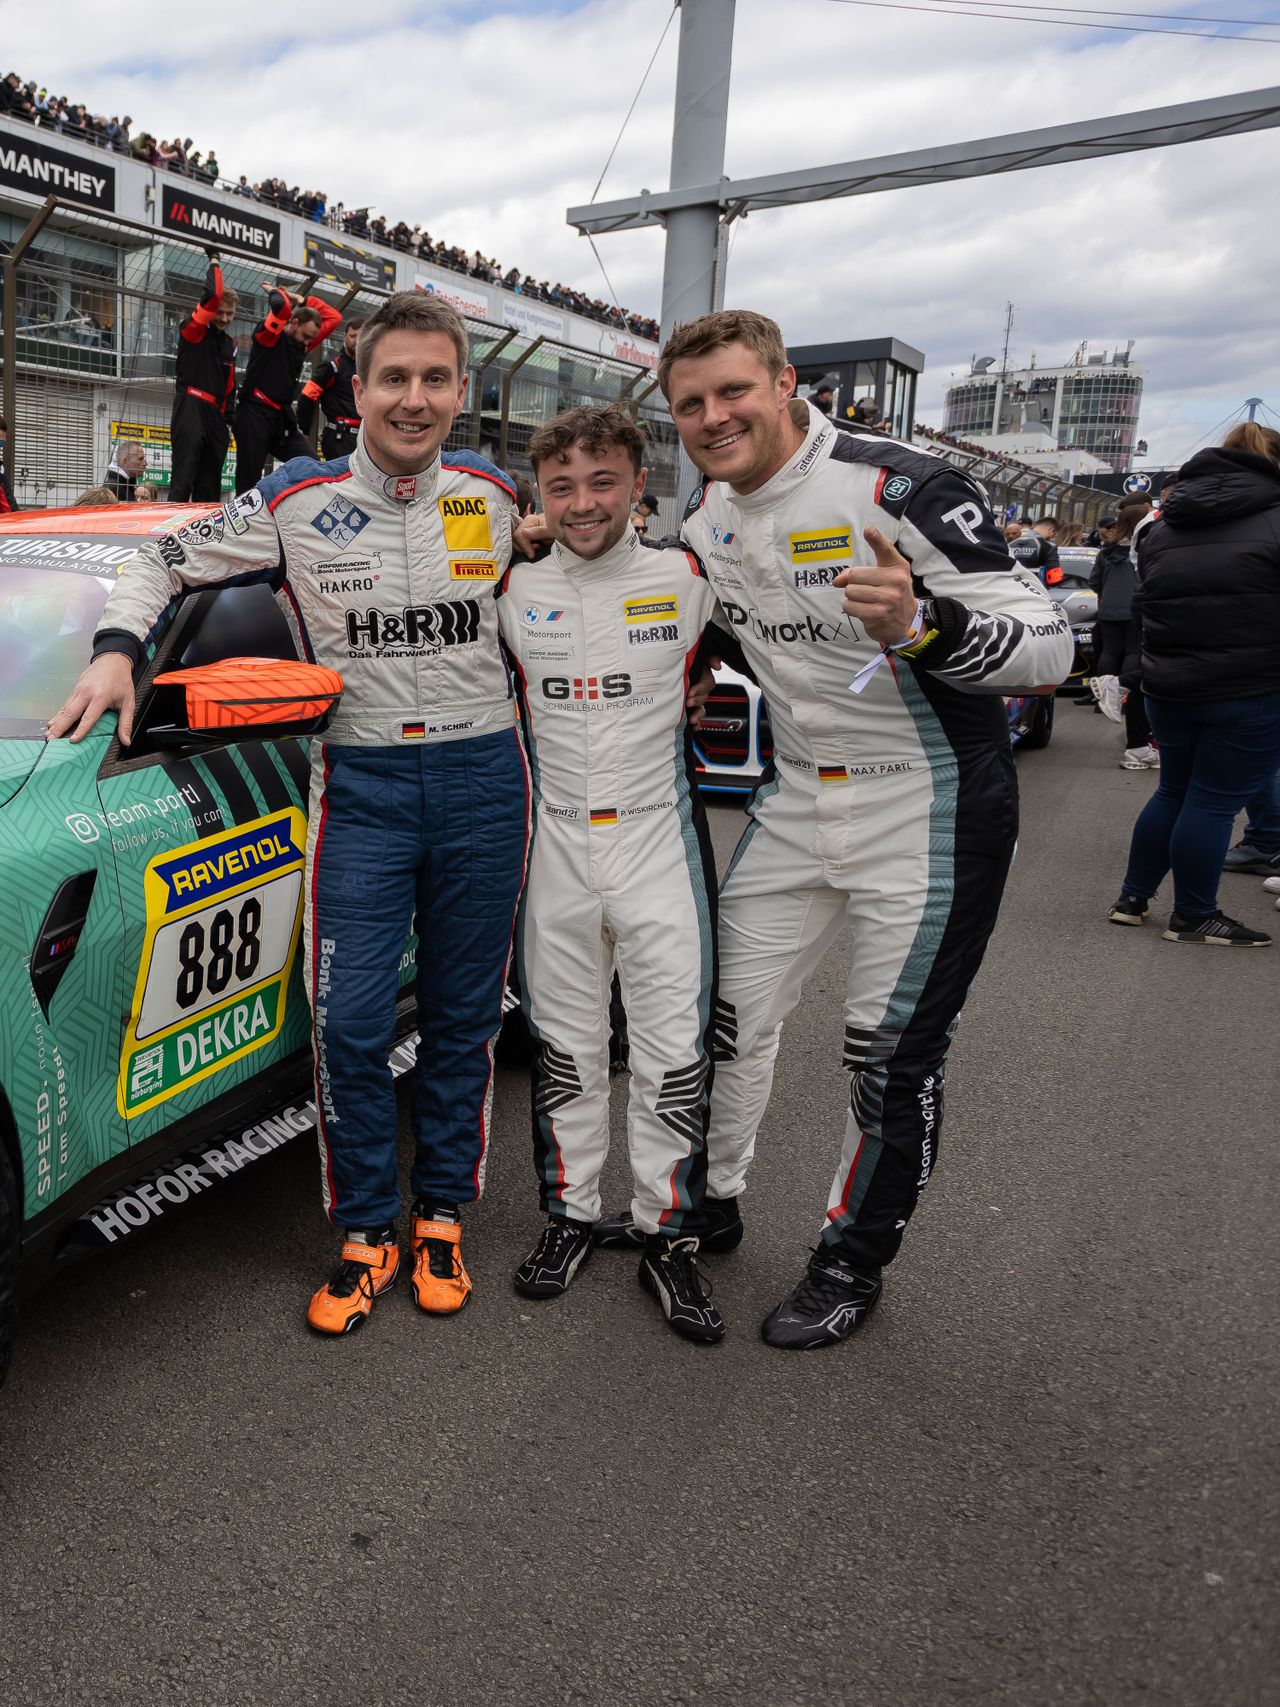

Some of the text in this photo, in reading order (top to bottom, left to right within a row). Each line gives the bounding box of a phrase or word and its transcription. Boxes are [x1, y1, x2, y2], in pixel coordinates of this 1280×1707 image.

[190, 207, 274, 251] MANTHEY
[890, 481, 905, 494] 21
[443, 498, 487, 517] ADAC
[797, 538, 845, 551] RAVENOL
[19, 558, 113, 575] SIMULATOR
[334, 566, 372, 574] Motorsport
[454, 562, 496, 577] PIRELLI
[320, 577, 373, 594] HAKRO
[794, 567, 830, 589] H&R
[630, 604, 672, 614] RAVENOL
[346, 606, 441, 649] H&R
[527, 630, 572, 640] Motorsport
[628, 627, 661, 645] H&R
[348, 650, 372, 659] Das
[606, 697, 654, 711] PROGRAM
[428, 721, 474, 734] M. SCHREY
[850, 761, 913, 776] MAX PARTL
[96, 783, 202, 829] team.partl
[620, 801, 674, 817] P. WISKIRCHEN
[112, 805, 228, 852] follow us, if you can!
[172, 838, 291, 896] RAVENOL
[175, 896, 263, 1011] 888
[176, 994, 270, 1077] DEKRA
[316, 938, 341, 1124] Bonk Motorsport
[130, 1078, 163, 1101] nürburgring
[35, 1022, 51, 1197] SPEED. noun
[57, 1132, 68, 1165] am
[91, 1106, 314, 1243] HOFOR RACING
